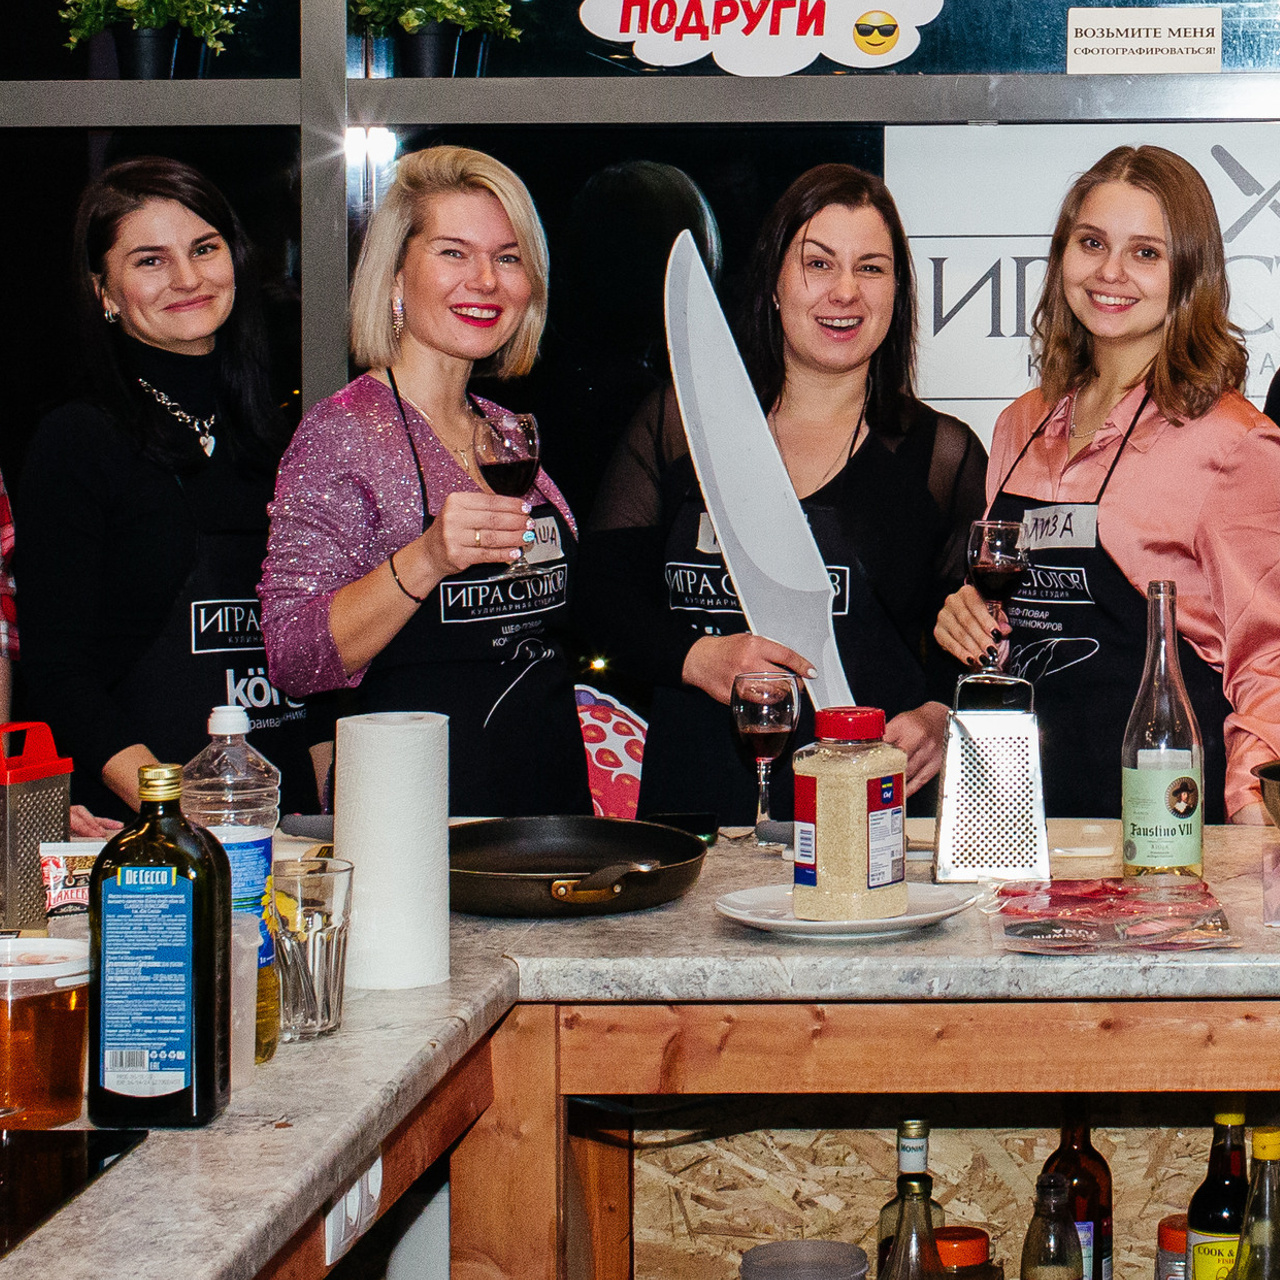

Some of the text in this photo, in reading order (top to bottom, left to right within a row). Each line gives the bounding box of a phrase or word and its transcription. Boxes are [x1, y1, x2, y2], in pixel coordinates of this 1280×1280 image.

[1074, 27, 1215, 38] ВОЗЬМИТЕ МЕНЯ
[1074, 47, 1216, 55] СФОТОГРАФИРОВАТЬСЯ!
[1028, 512, 1073, 541] ЛИЗА
[447, 570, 564, 608] ИГРА СТОЛОВ
[668, 569, 717, 595] ИГРА
[471, 601, 532, 616] КУЛИНАРНАЯ
[200, 606, 260, 633] ИГРА
[1130, 822, 1192, 838] Faustino VII
[1197, 1246, 1225, 1257] COOK
